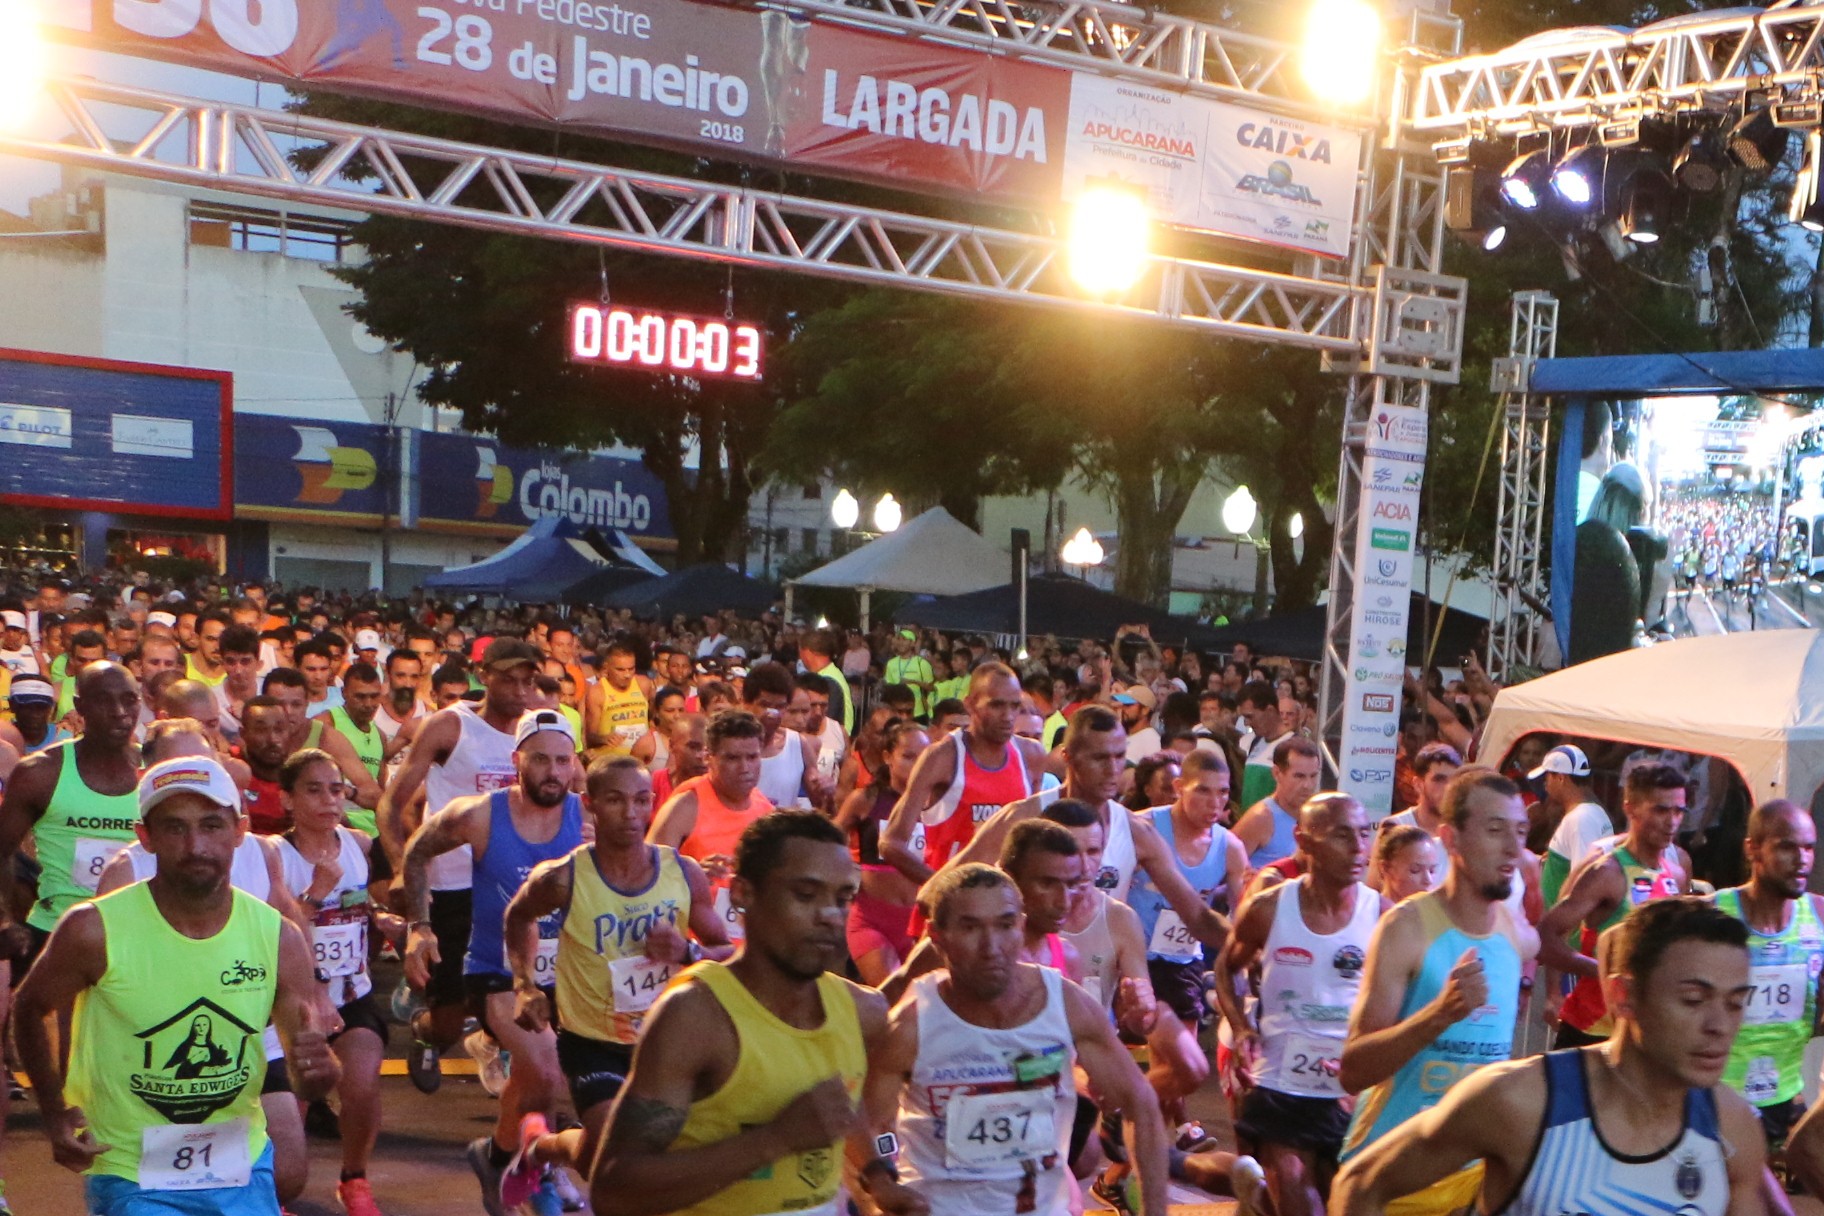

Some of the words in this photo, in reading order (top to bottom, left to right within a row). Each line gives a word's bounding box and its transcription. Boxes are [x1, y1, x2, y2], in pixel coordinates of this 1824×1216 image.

[416, 7, 493, 71] 28
[508, 41, 557, 84] de
[567, 35, 749, 117] Janeiro
[821, 69, 1047, 164] LARGADA
[700, 120, 745, 143] 2018
[1082, 121, 1196, 157] APUCARANA
[1236, 122, 1332, 164] CAIXA
[1092, 144, 1137, 162] Prefeitura
[1149, 153, 1182, 170] Cidade
[1234, 172, 1323, 206] BRASIL
[574, 307, 760, 376] 00:00:03
[541, 459, 562, 480] lojas
[519, 468, 651, 530] Colombo
[1373, 500, 1412, 520] ACIA
[1363, 575, 1408, 588] UniCesumar
[1364, 615, 1402, 626] HIROSE
[611, 710, 646, 722] CAIXA
[313, 941, 354, 961] 831
[623, 965, 670, 997] 144
[1745, 983, 1791, 1006] 718
[130, 1072, 184, 1095] SANTA
[188, 1065, 250, 1095] EDWIGES
[967, 1109, 1032, 1145] 437
[173, 1143, 213, 1171] 81
